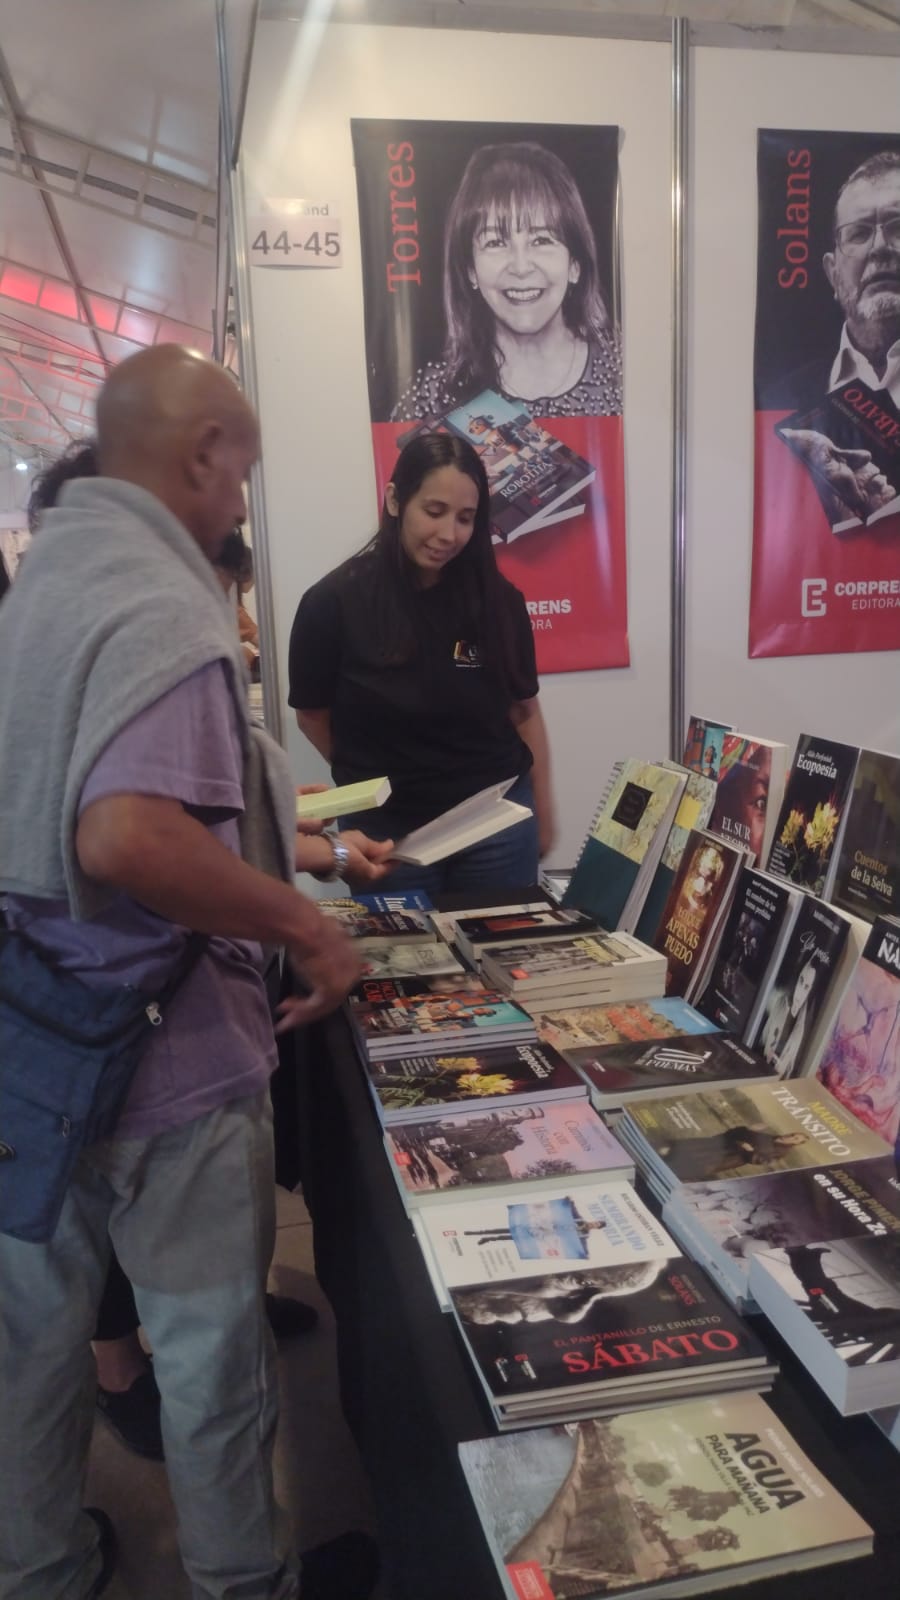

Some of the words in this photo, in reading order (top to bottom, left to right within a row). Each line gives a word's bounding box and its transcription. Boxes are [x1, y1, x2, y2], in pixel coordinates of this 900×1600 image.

[387, 140, 422, 294] Torres
[777, 148, 812, 290] Solans
[251, 230, 341, 257] 44-45
[834, 580, 900, 597] CORPRE
[526, 598, 572, 616] RENS
[796, 753, 838, 779] Ecopoesía
[733, 822, 752, 841] SUR
[854, 849, 888, 875] Cuentos
[871, 874, 893, 897] Selva
[665, 917, 700, 950] APENAS
[663, 934, 693, 966] PUEDO
[771, 1086, 851, 1156] TRÁNSITO
[812, 1173, 833, 1188] en
[826, 1186, 847, 1200] su
[840, 1199, 873, 1223] Hora
[570, 1326, 646, 1345] PANTANILLO
[648, 1323, 665, 1333] DE
[666, 1315, 721, 1331] ERNESTO
[562, 1328, 739, 1374] SÁBATO
[705, 1434, 733, 1465] PARA
[726, 1466, 771, 1514] MAÑANA
[724, 1432, 807, 1510] AGUA
